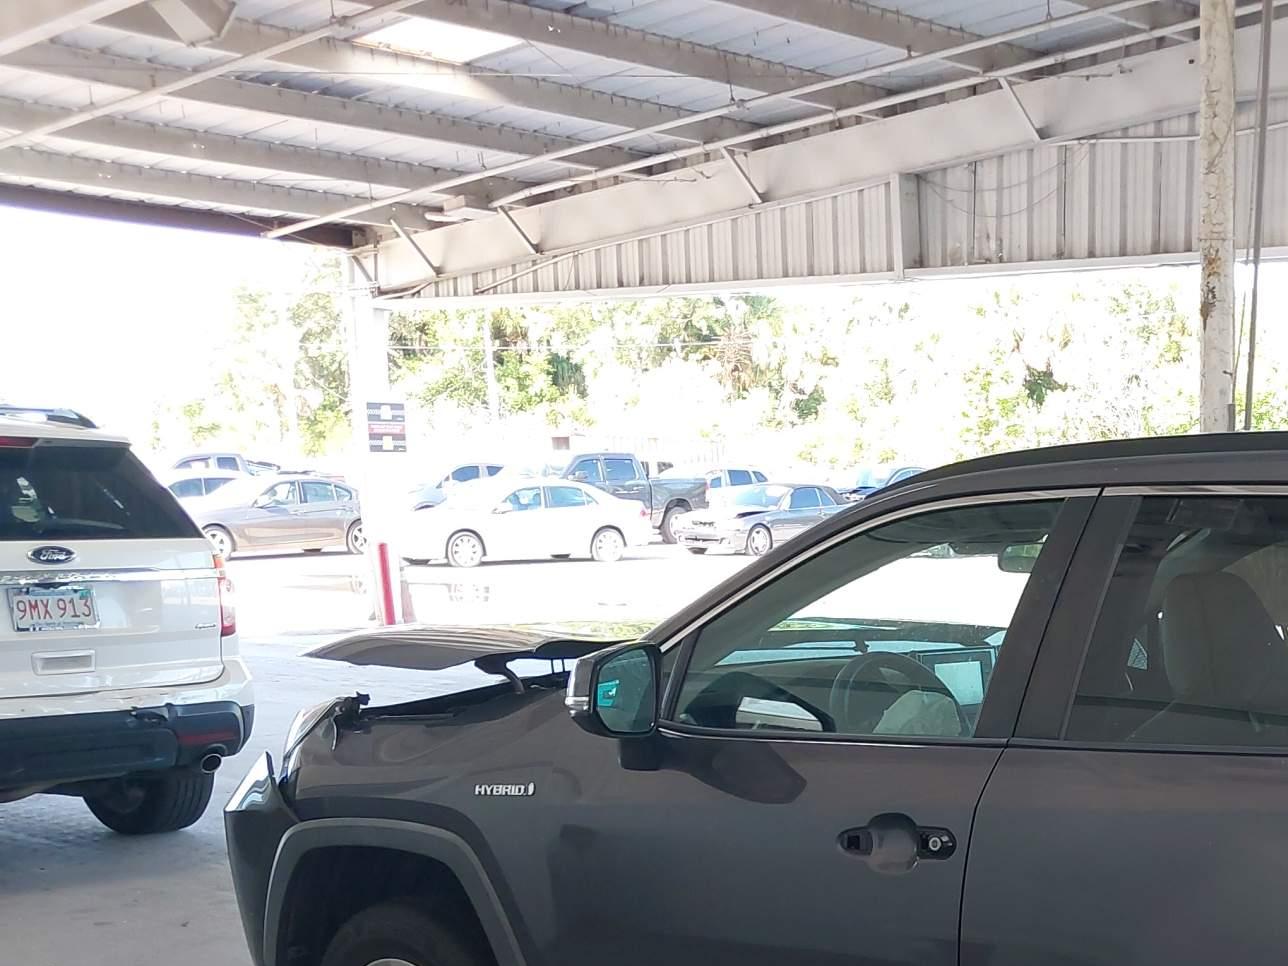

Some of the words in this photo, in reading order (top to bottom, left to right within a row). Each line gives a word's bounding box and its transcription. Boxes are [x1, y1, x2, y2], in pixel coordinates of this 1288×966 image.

[40, 549, 67, 560] Ford
[16, 599, 52, 620] 9MX
[57, 597, 91, 618] 913
[475, 784, 525, 796] HYBRID
